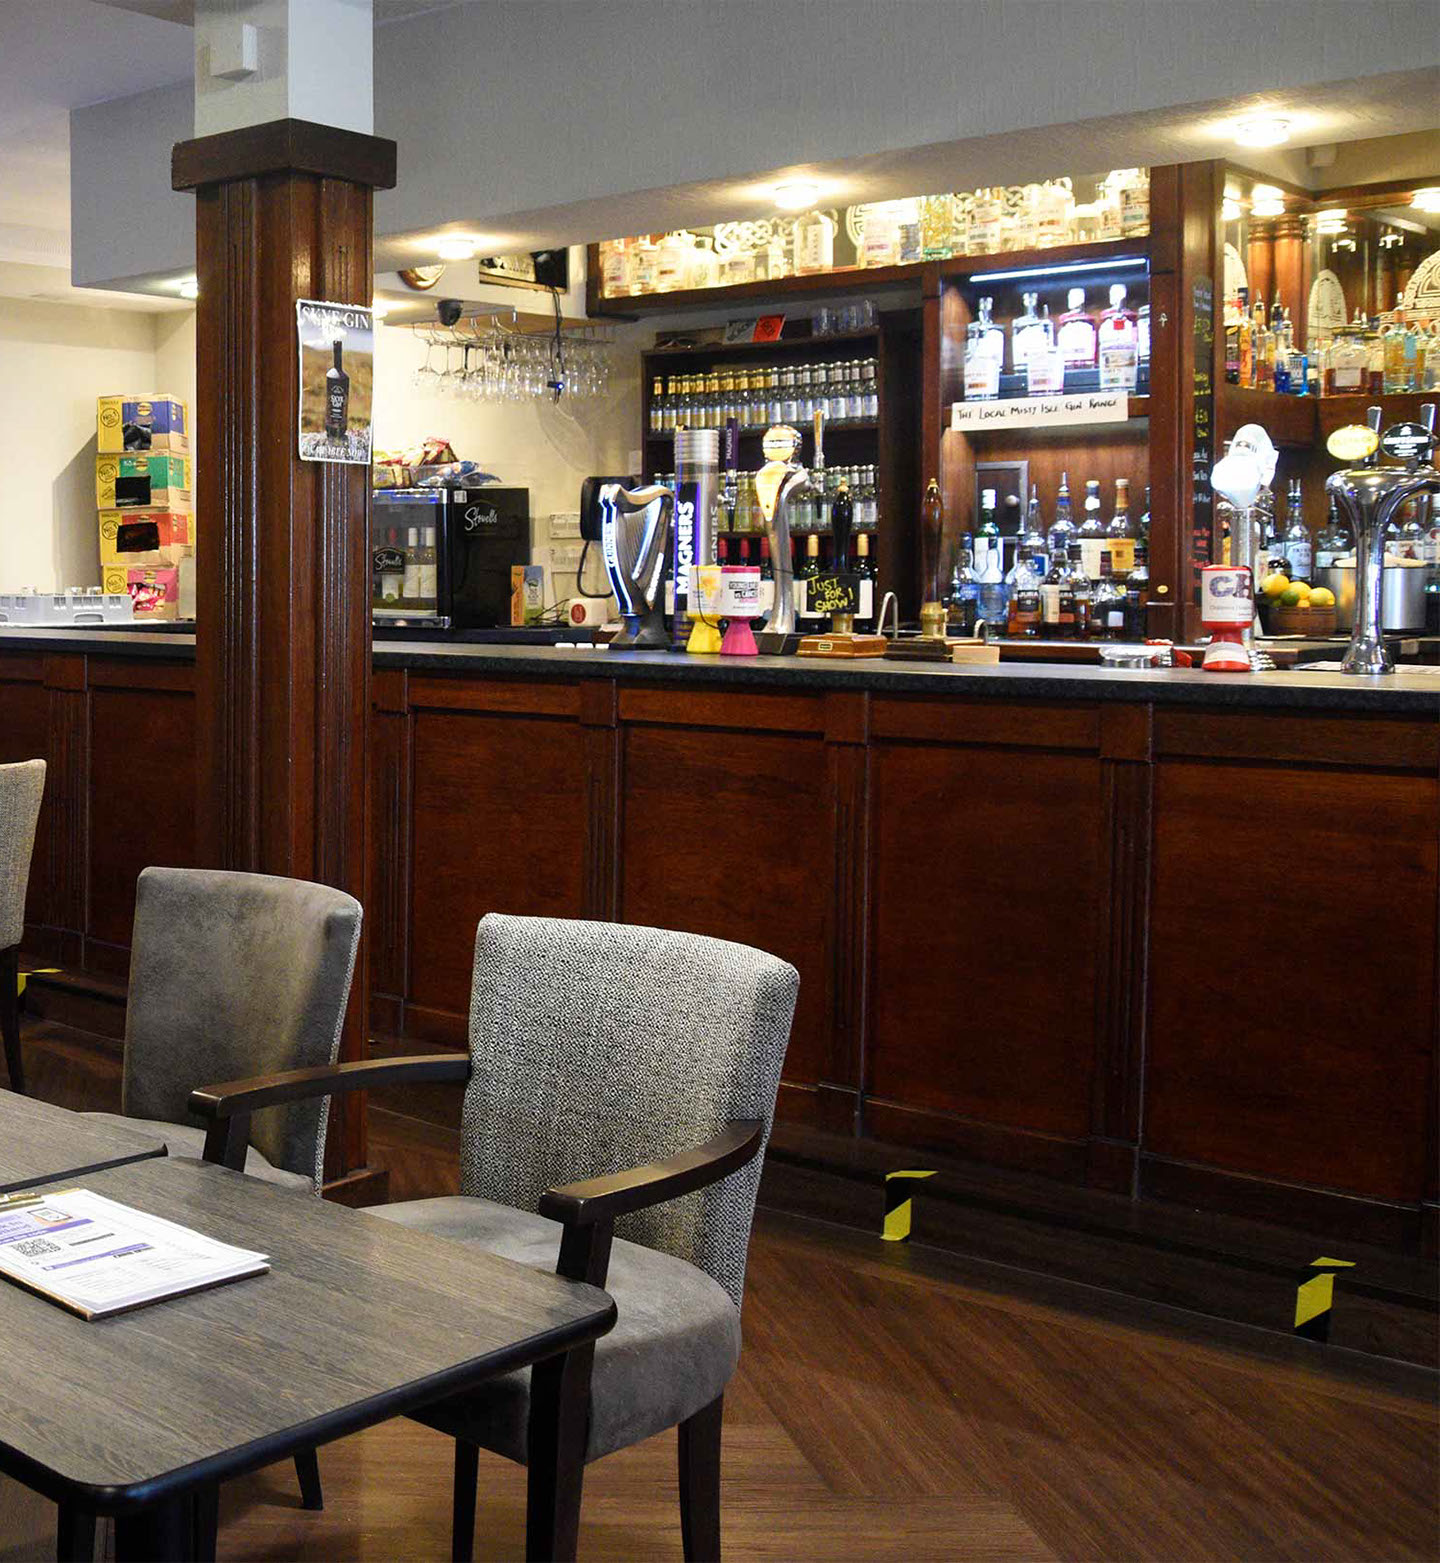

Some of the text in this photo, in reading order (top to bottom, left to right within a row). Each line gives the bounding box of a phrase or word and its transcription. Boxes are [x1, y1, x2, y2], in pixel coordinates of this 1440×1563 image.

[343, 312, 369, 329] GIN
[979, 407, 1006, 420] LOCAL
[1064, 402, 1083, 412] GIN
[1089, 399, 1118, 408] RANGE
[675, 500, 695, 594] MAGNERS
[807, 575, 839, 595] JUST
[824, 587, 844, 600] FOR
